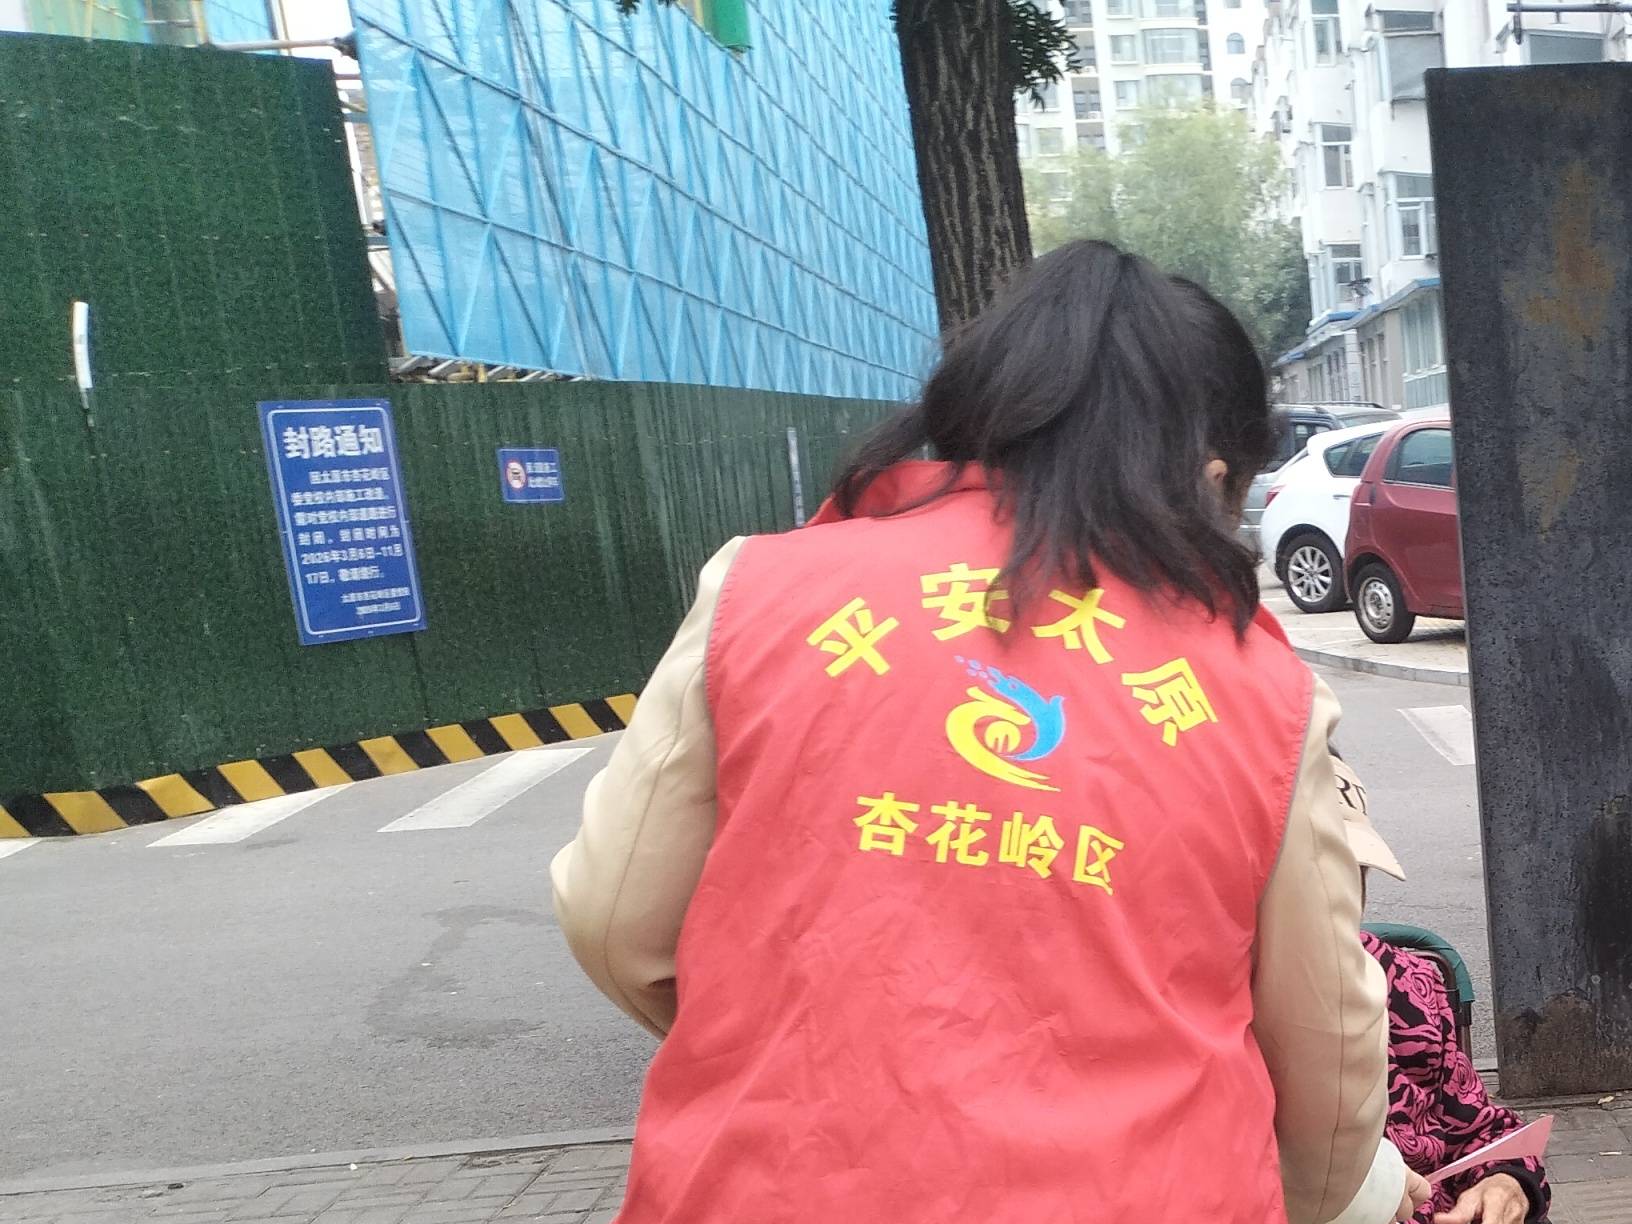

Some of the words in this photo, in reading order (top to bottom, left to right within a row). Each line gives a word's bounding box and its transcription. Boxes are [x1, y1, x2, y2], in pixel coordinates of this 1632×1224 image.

[283, 424, 384, 459] 封路通知
[805, 562, 1219, 747] 平安太原
[853, 791, 1125, 897] 杏花岭区
